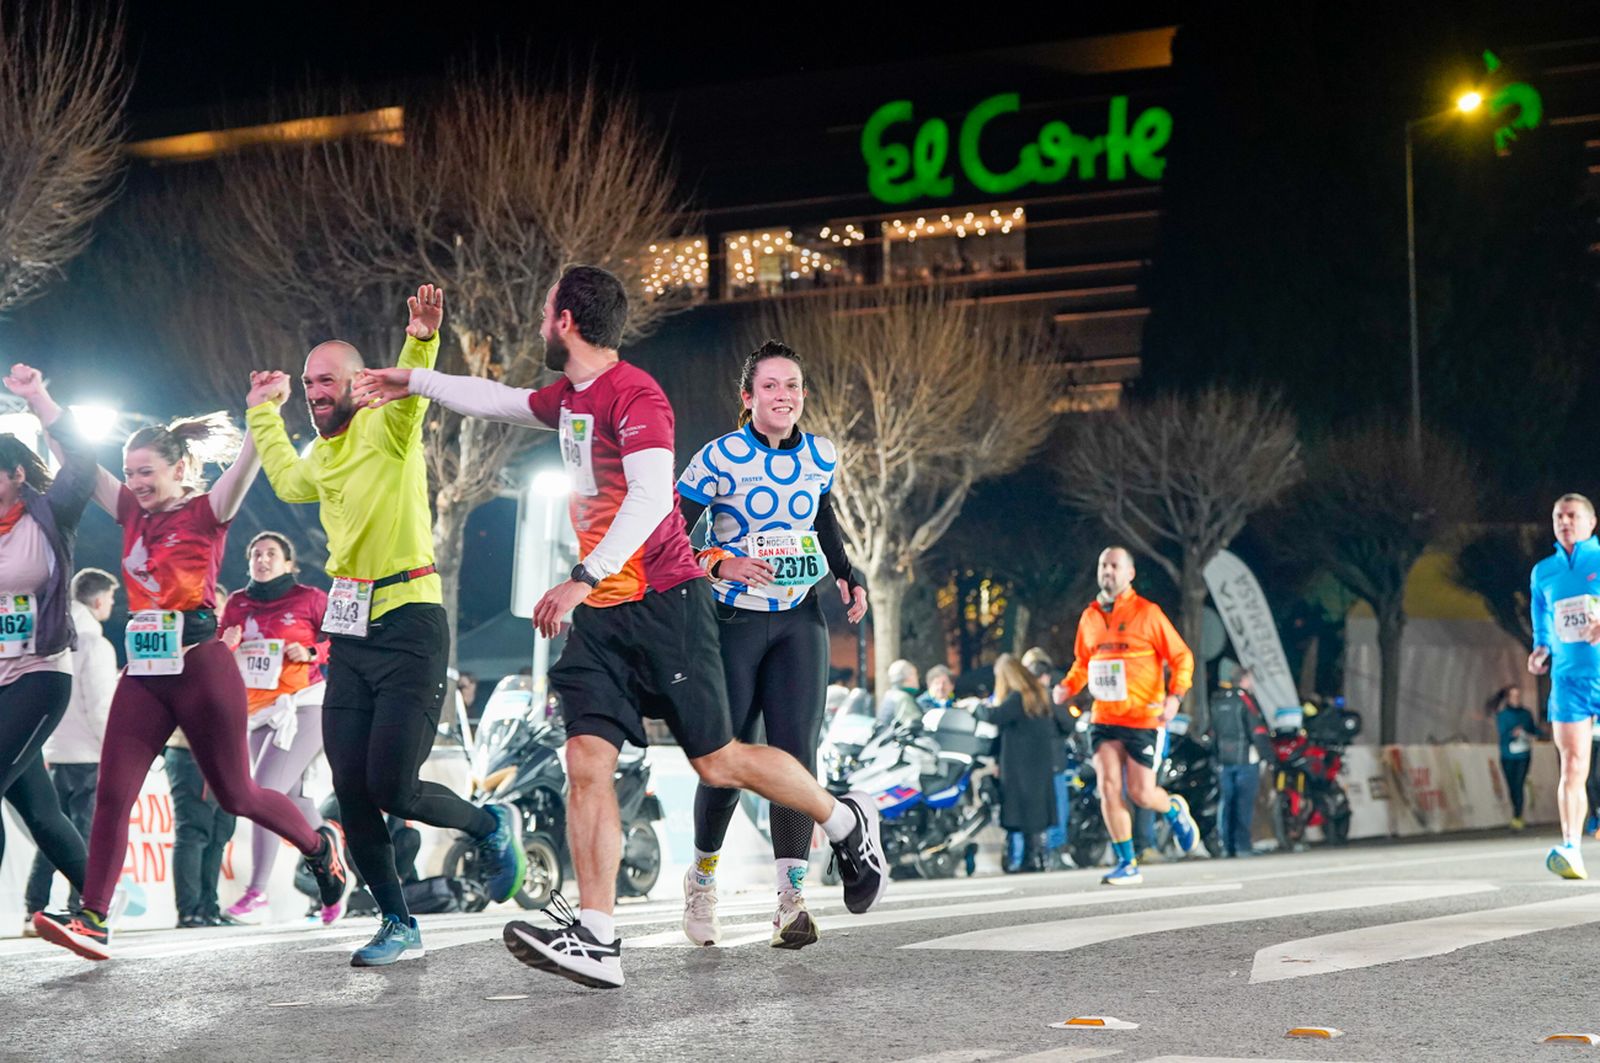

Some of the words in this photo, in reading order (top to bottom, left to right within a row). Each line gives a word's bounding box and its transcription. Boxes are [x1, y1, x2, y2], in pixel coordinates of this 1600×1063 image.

[861, 99, 954, 204] El
[959, 92, 1174, 194] Corte
[758, 548, 774, 558] SAN
[1563, 611, 1593, 628] 253
[134, 632, 168, 653] 9401
[247, 656, 271, 672] 1749
[128, 794, 174, 834] AN
